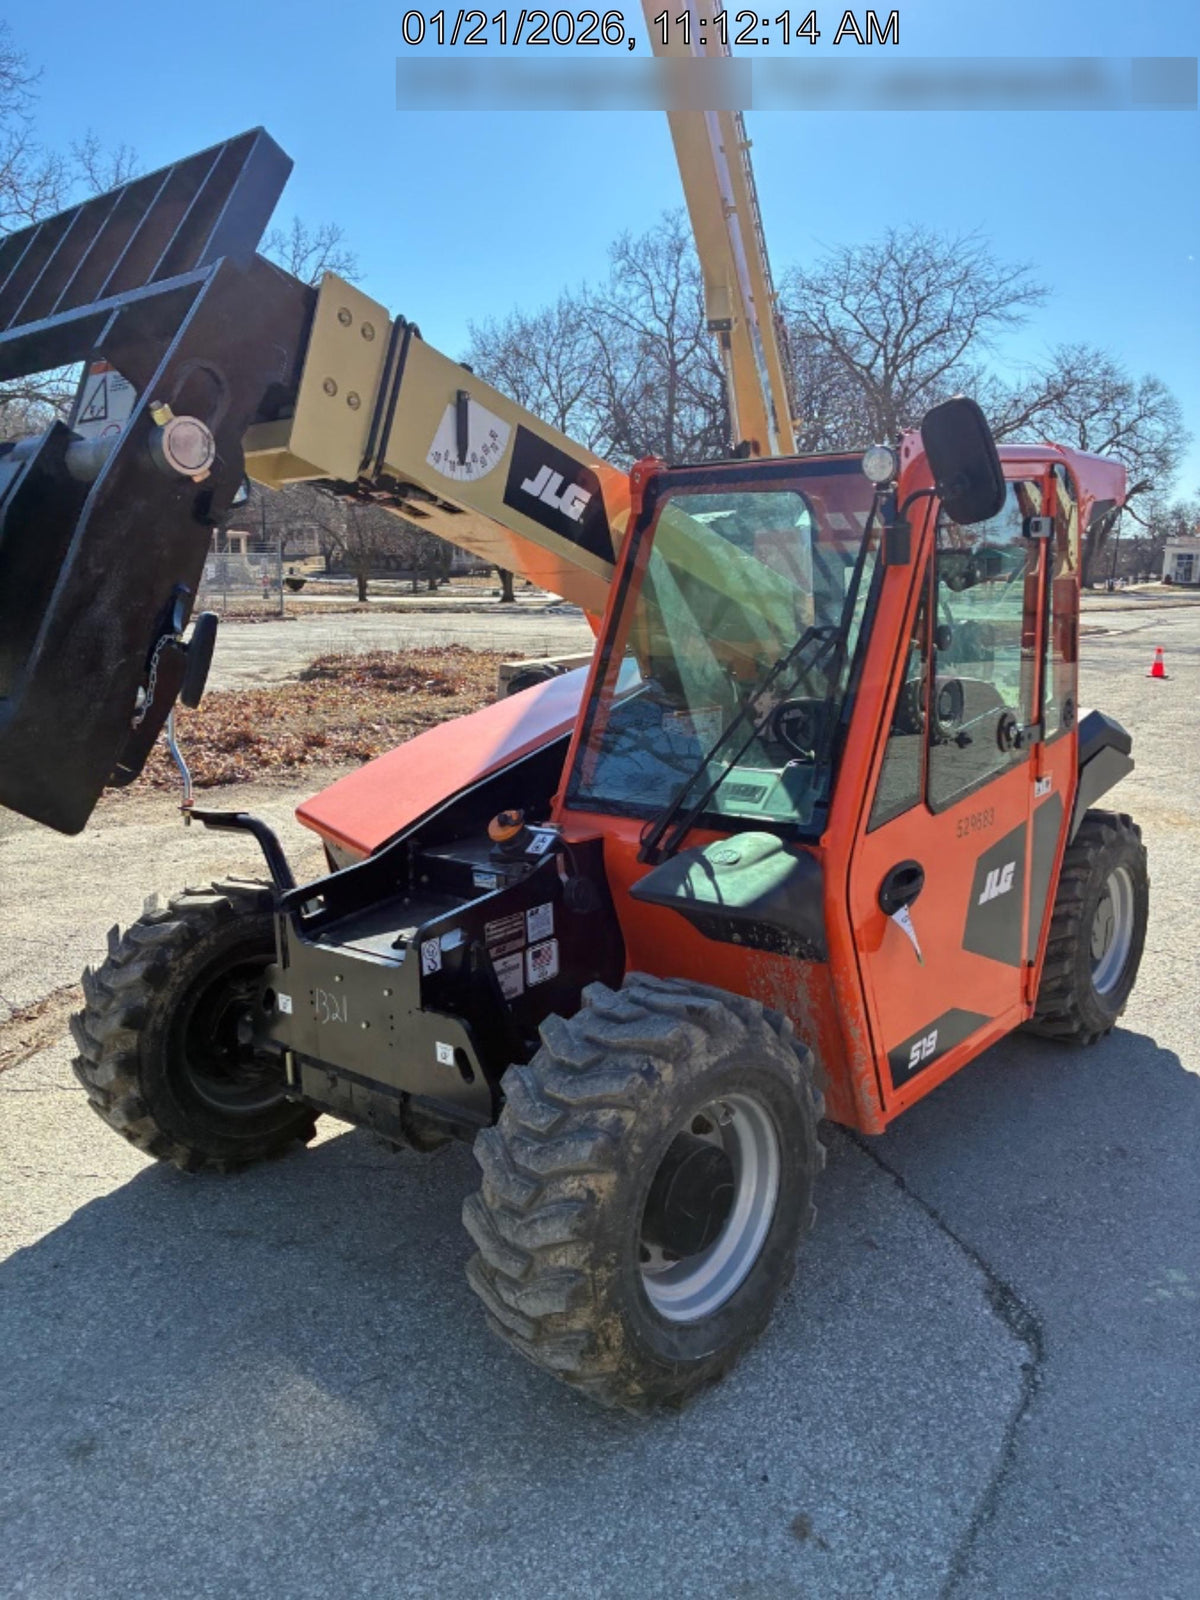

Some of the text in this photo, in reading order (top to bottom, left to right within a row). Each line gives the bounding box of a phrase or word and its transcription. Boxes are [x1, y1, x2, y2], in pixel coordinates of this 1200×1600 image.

[520, 464, 592, 522] JLG
[978, 861, 1016, 905] JLG
[315, 987, 348, 1024] 1321
